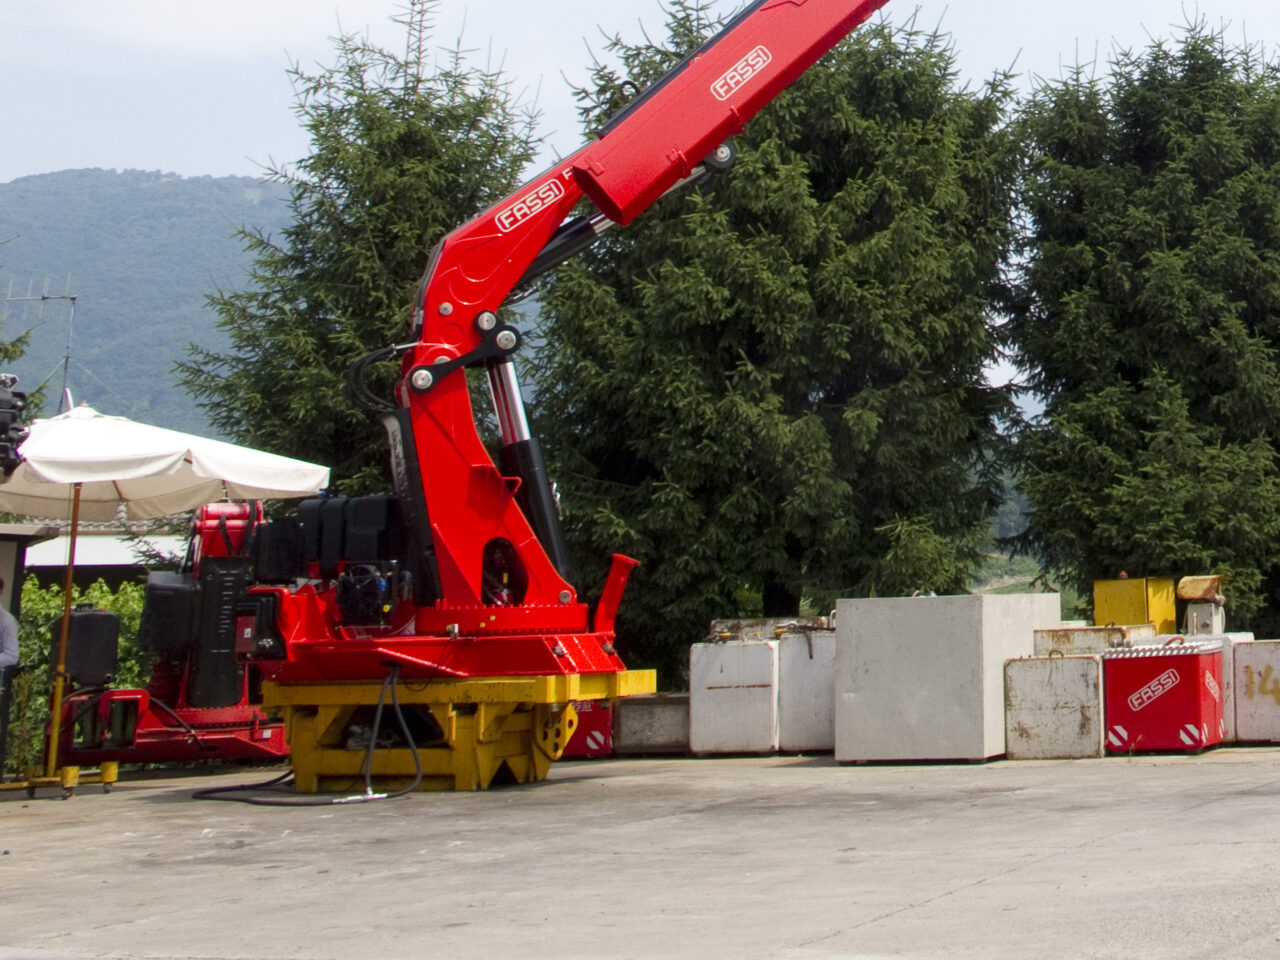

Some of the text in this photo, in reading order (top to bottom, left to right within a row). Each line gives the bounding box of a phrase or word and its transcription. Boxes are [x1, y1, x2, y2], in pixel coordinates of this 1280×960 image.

[714, 50, 767, 96] FASSI
[500, 183, 559, 228] FASSI
[1132, 672, 1176, 707] FASSI
